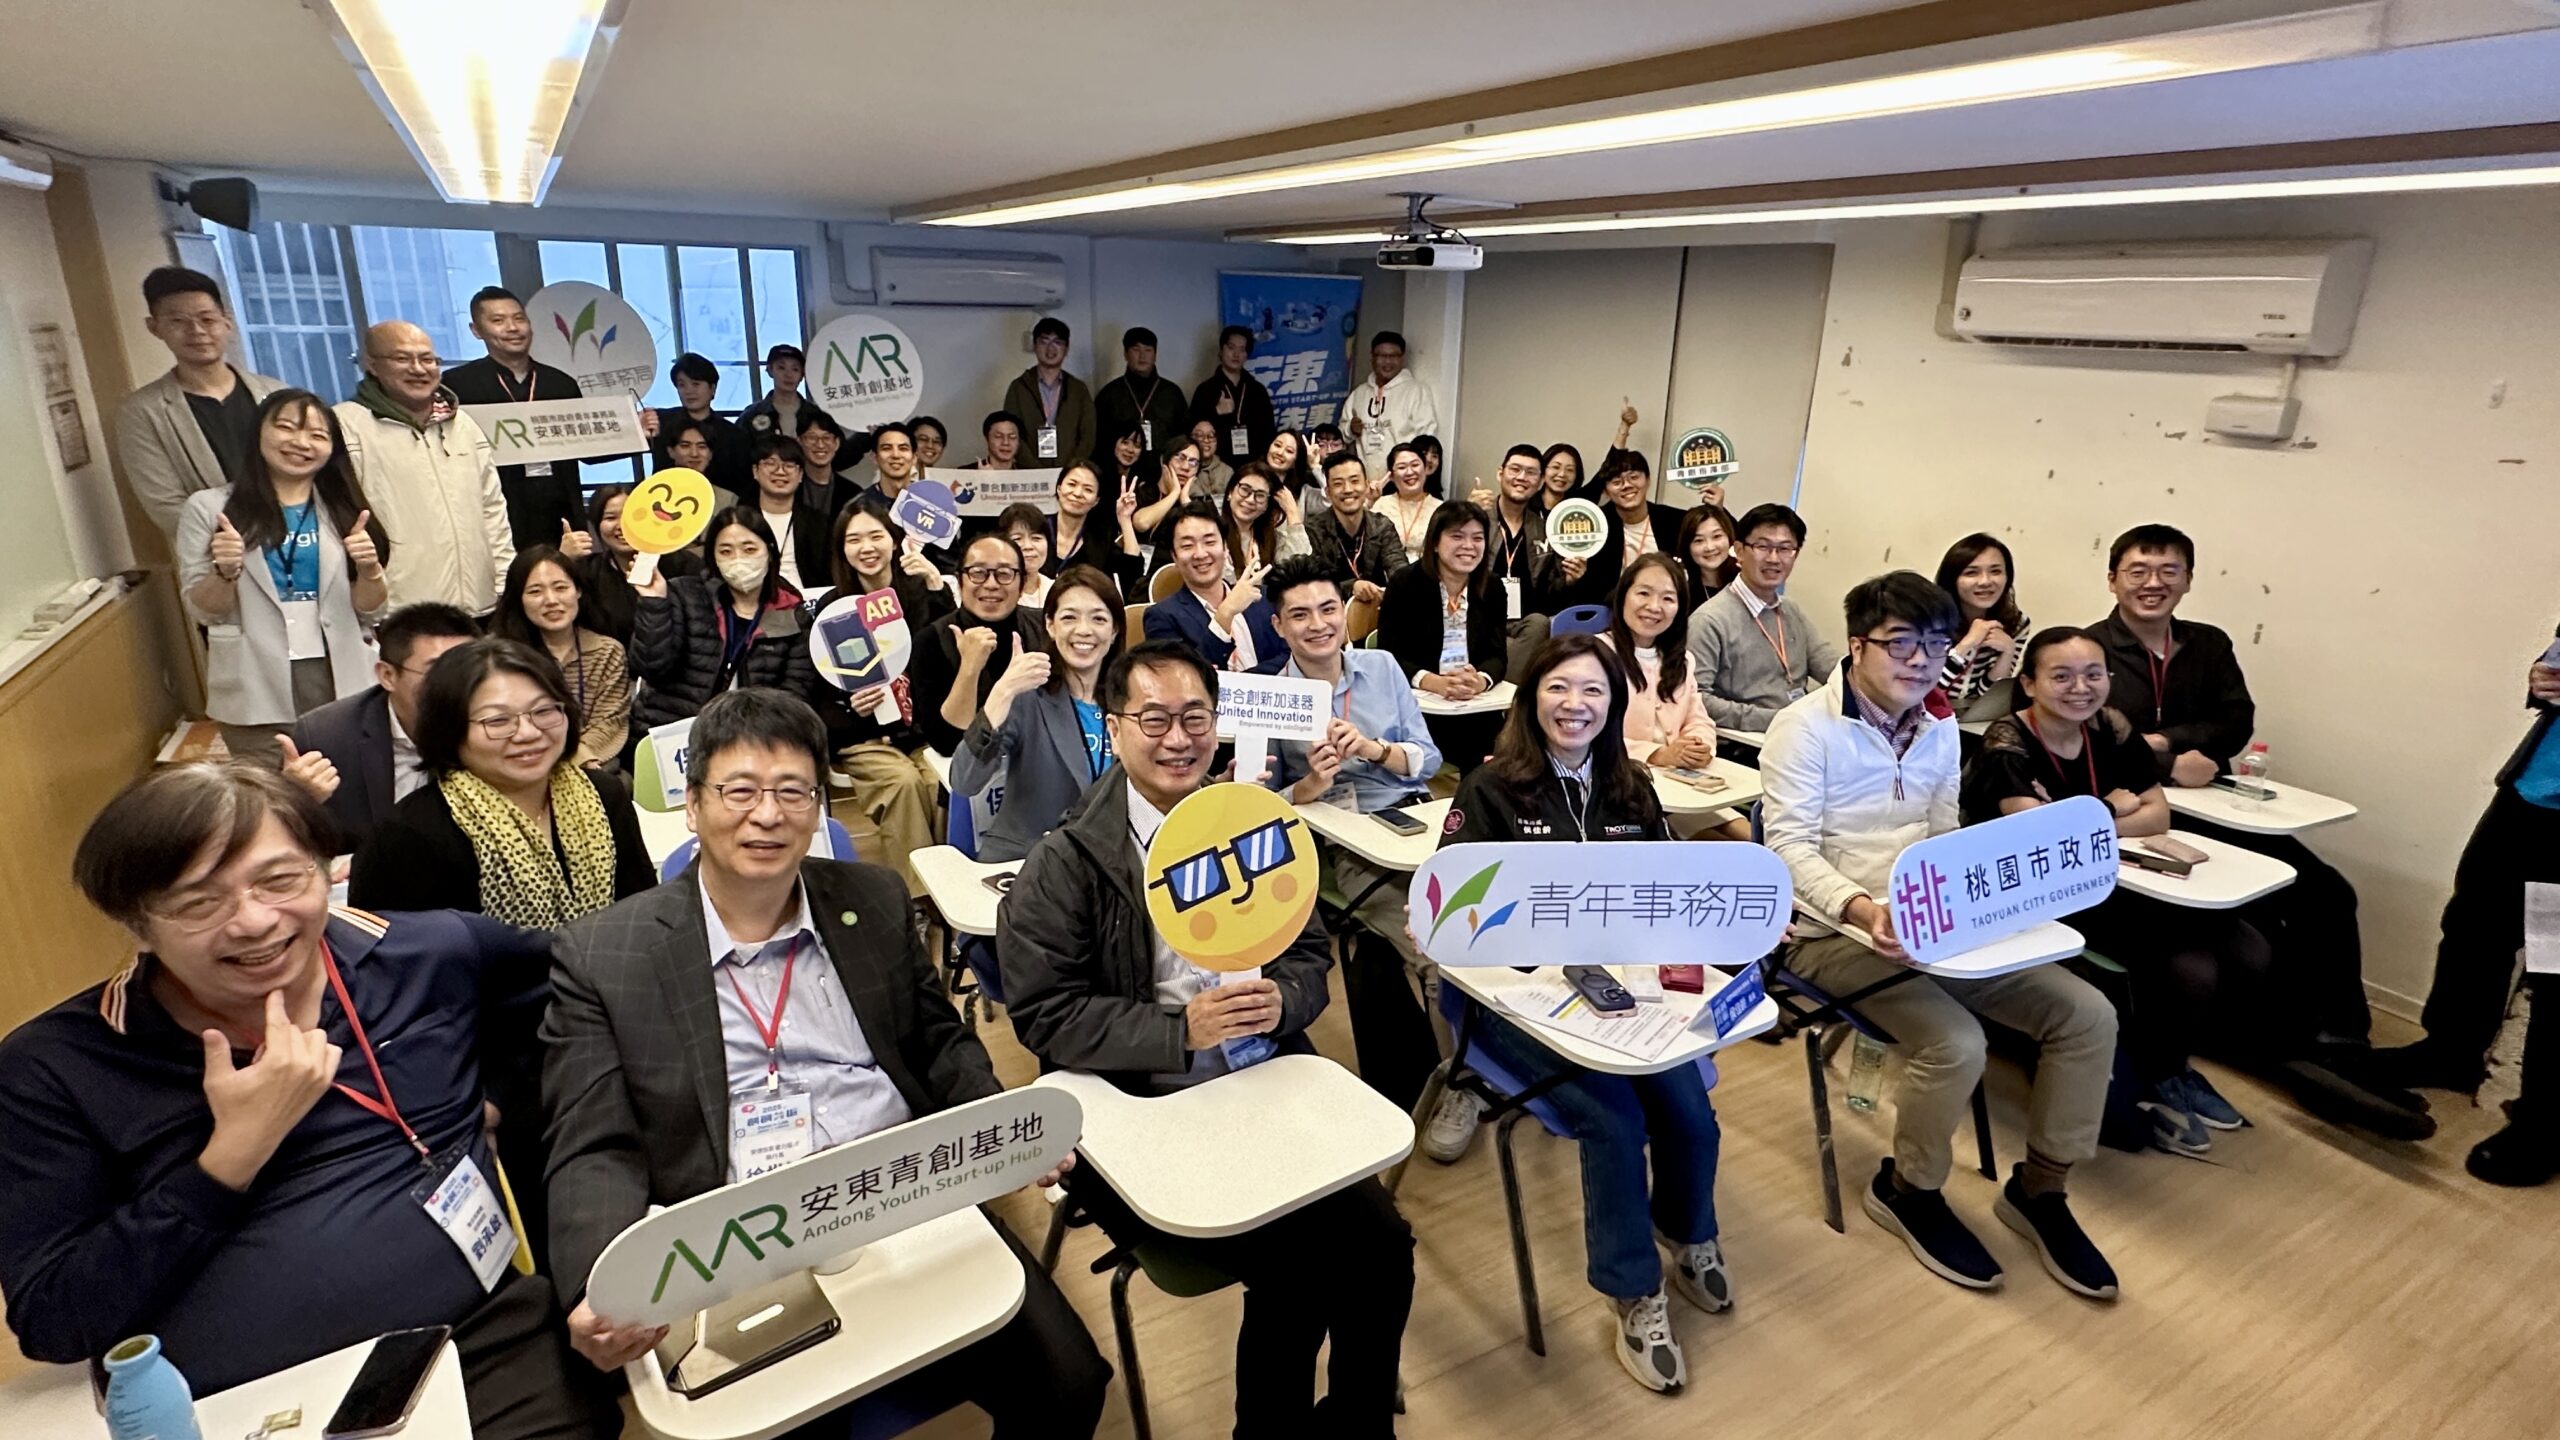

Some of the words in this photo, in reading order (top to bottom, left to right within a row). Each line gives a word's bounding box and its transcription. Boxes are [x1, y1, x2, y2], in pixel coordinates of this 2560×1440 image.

[577, 364, 652, 392] 年事務局
[823, 376, 914, 401] 安東青創基地
[534, 419, 621, 438] 安東青創基地
[916, 511, 935, 530] VR
[865, 595, 897, 622] AR
[1218, 686, 1314, 711] 聯合創新加速器
[1218, 705, 1254, 718] United
[1257, 709, 1313, 723] Innovation
[1964, 827, 2112, 903] 桃園市政府
[1527, 880, 1778, 928] 青年事務局
[1971, 904, 2020, 929] TAOYUAN
[2023, 895, 2046, 911] CITY
[2049, 872, 2117, 903] GOVERNMENT
[800, 1111, 1044, 1222] 安東青創基地
[802, 1206, 876, 1242] Andong
[880, 1183, 931, 1212] Youth
[935, 1162, 1006, 1192] Start-up
[1010, 1145, 1043, 1165] Hub
